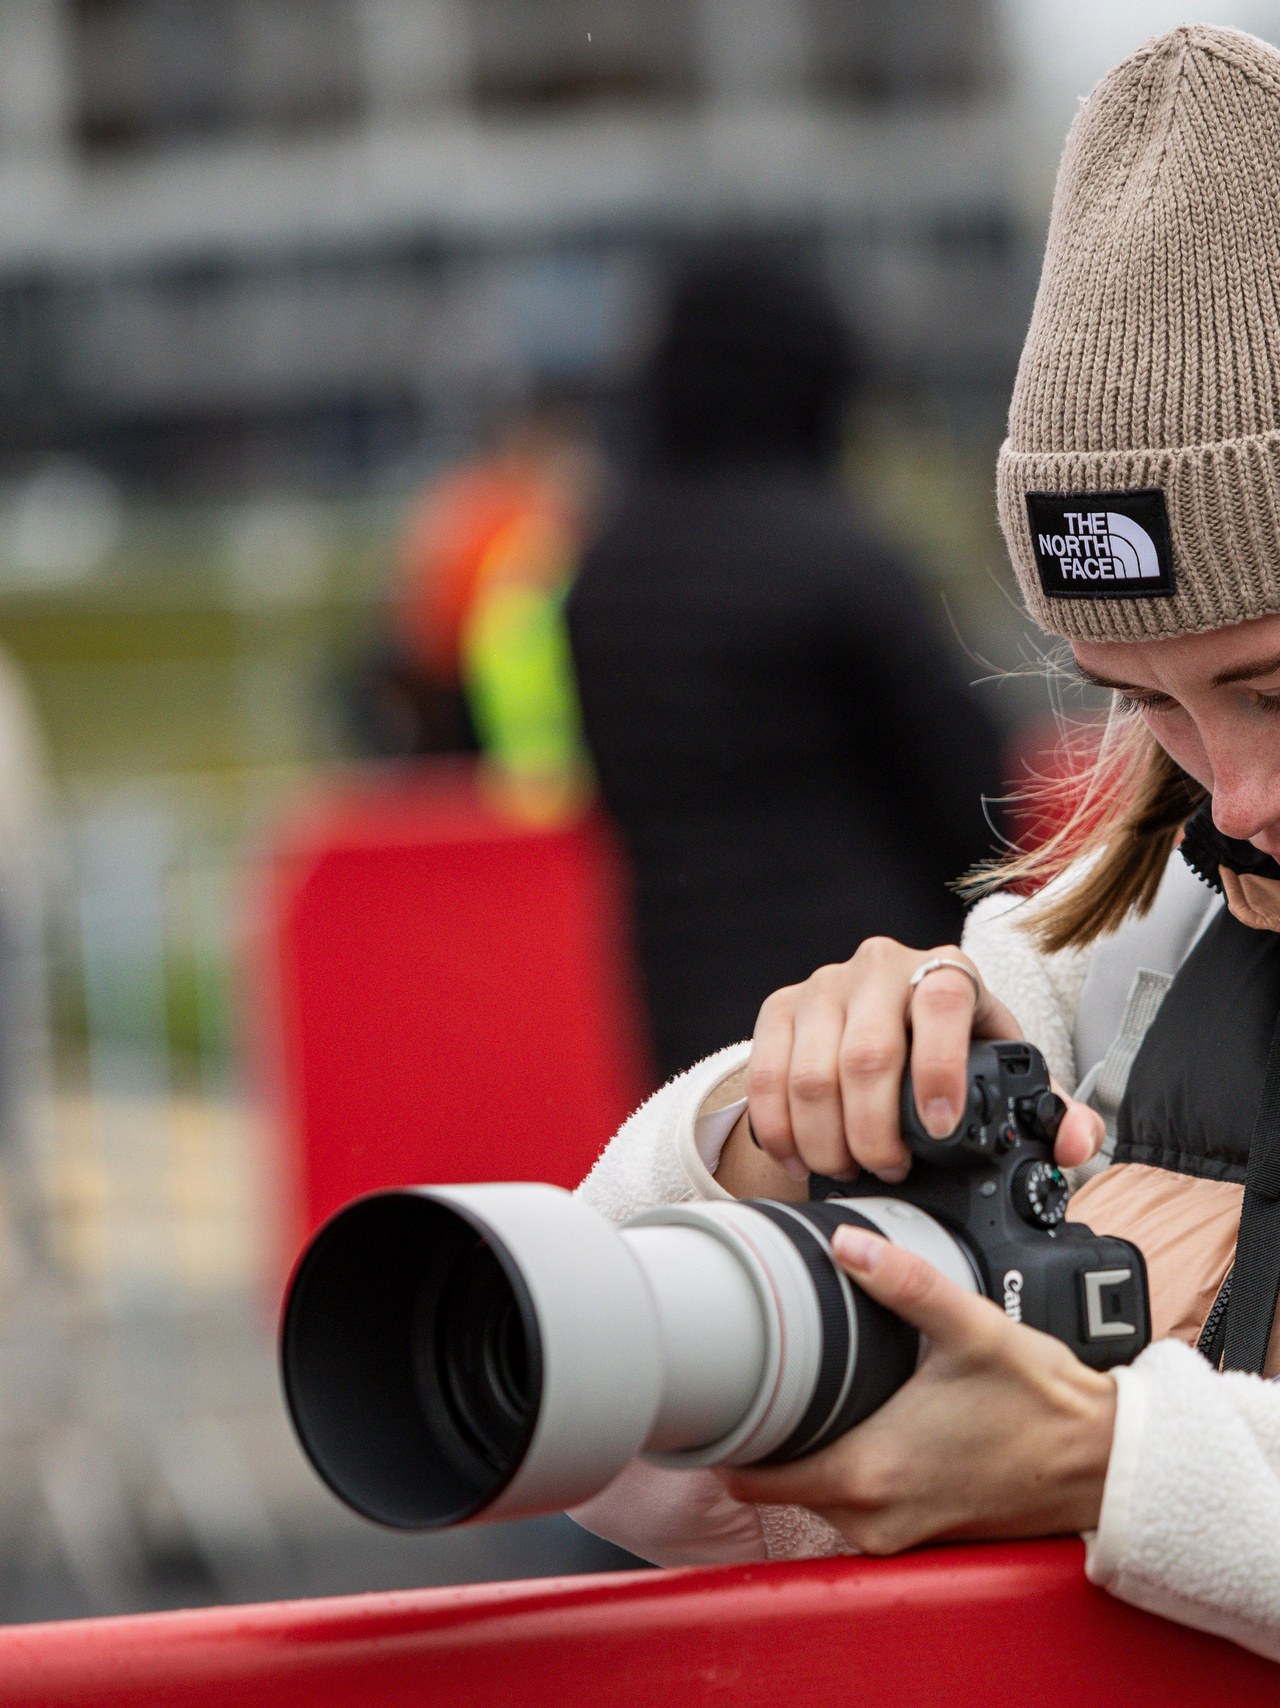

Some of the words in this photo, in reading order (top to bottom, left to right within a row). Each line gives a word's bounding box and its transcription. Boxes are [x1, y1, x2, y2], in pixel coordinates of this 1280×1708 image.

[1063, 512, 1107, 534] THE
[1038, 534, 1111, 557] NORTH
[1059, 557, 1114, 579] FACE
[1003, 1269, 1023, 1323] Can
